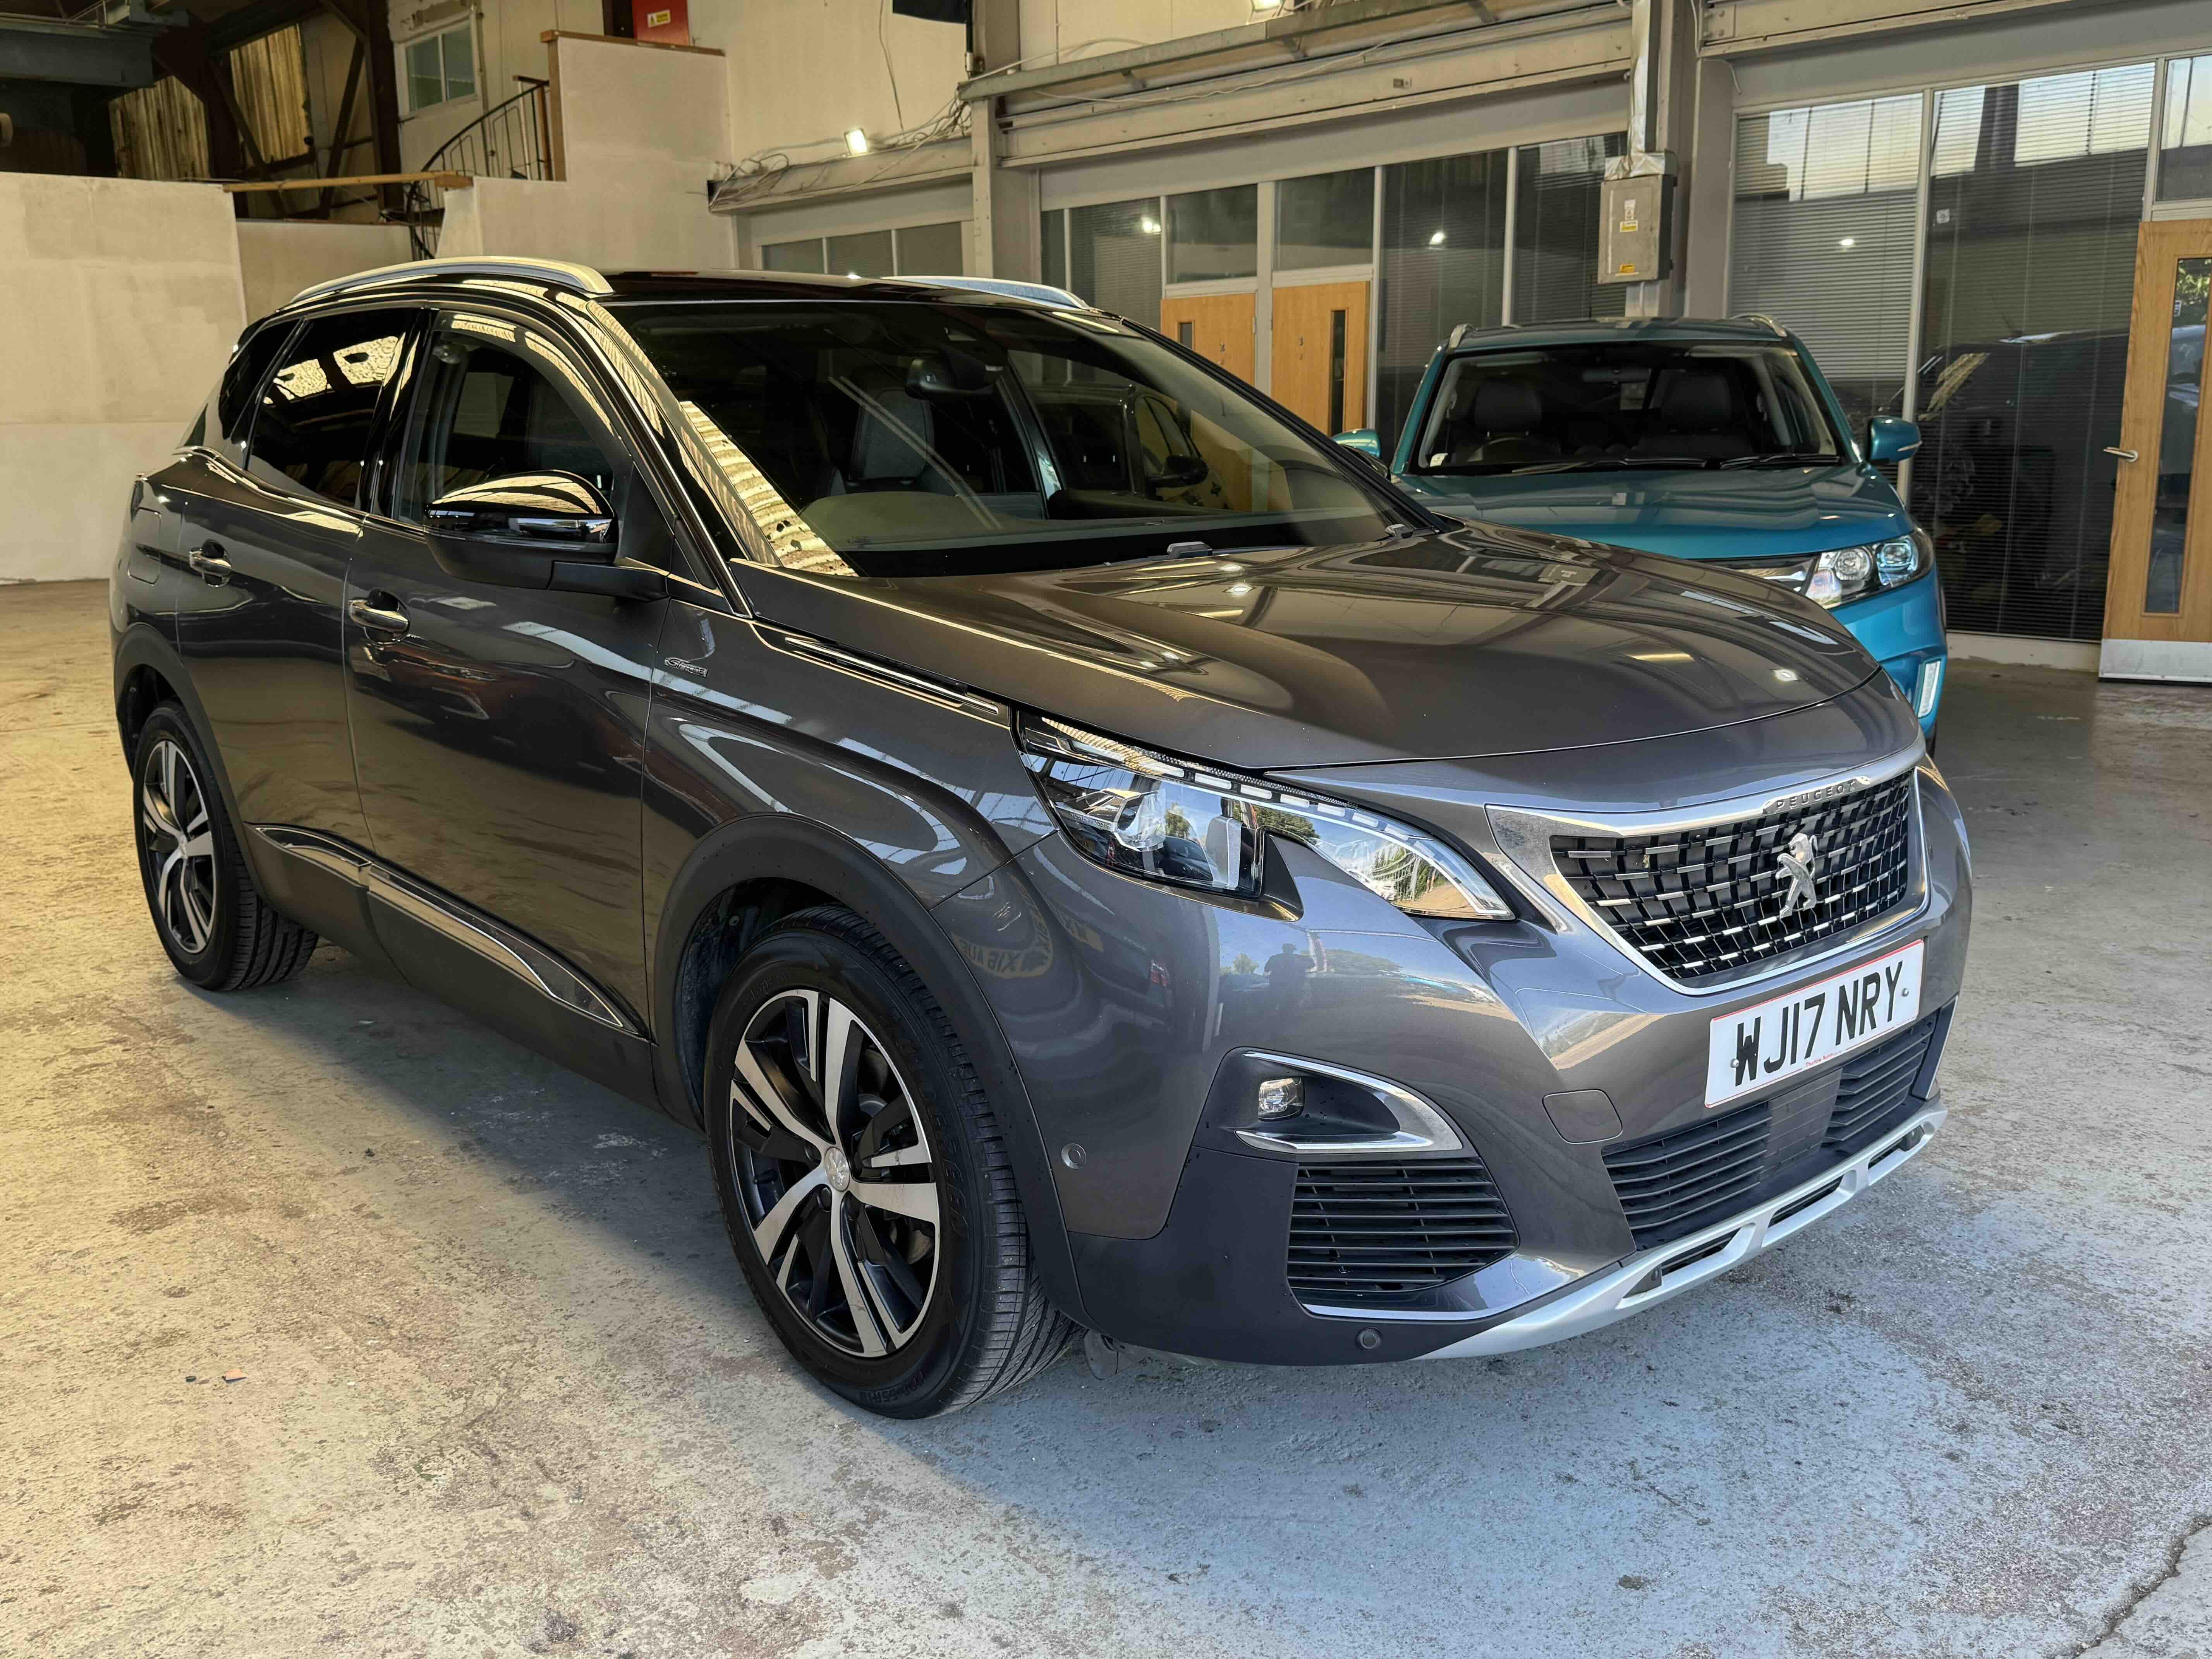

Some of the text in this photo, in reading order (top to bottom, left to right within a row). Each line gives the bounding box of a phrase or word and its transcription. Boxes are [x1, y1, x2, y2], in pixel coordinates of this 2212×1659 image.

[1776, 780, 1856, 810] PEUGEOT
[1735, 960, 1903, 1087] WJ17 NRY
